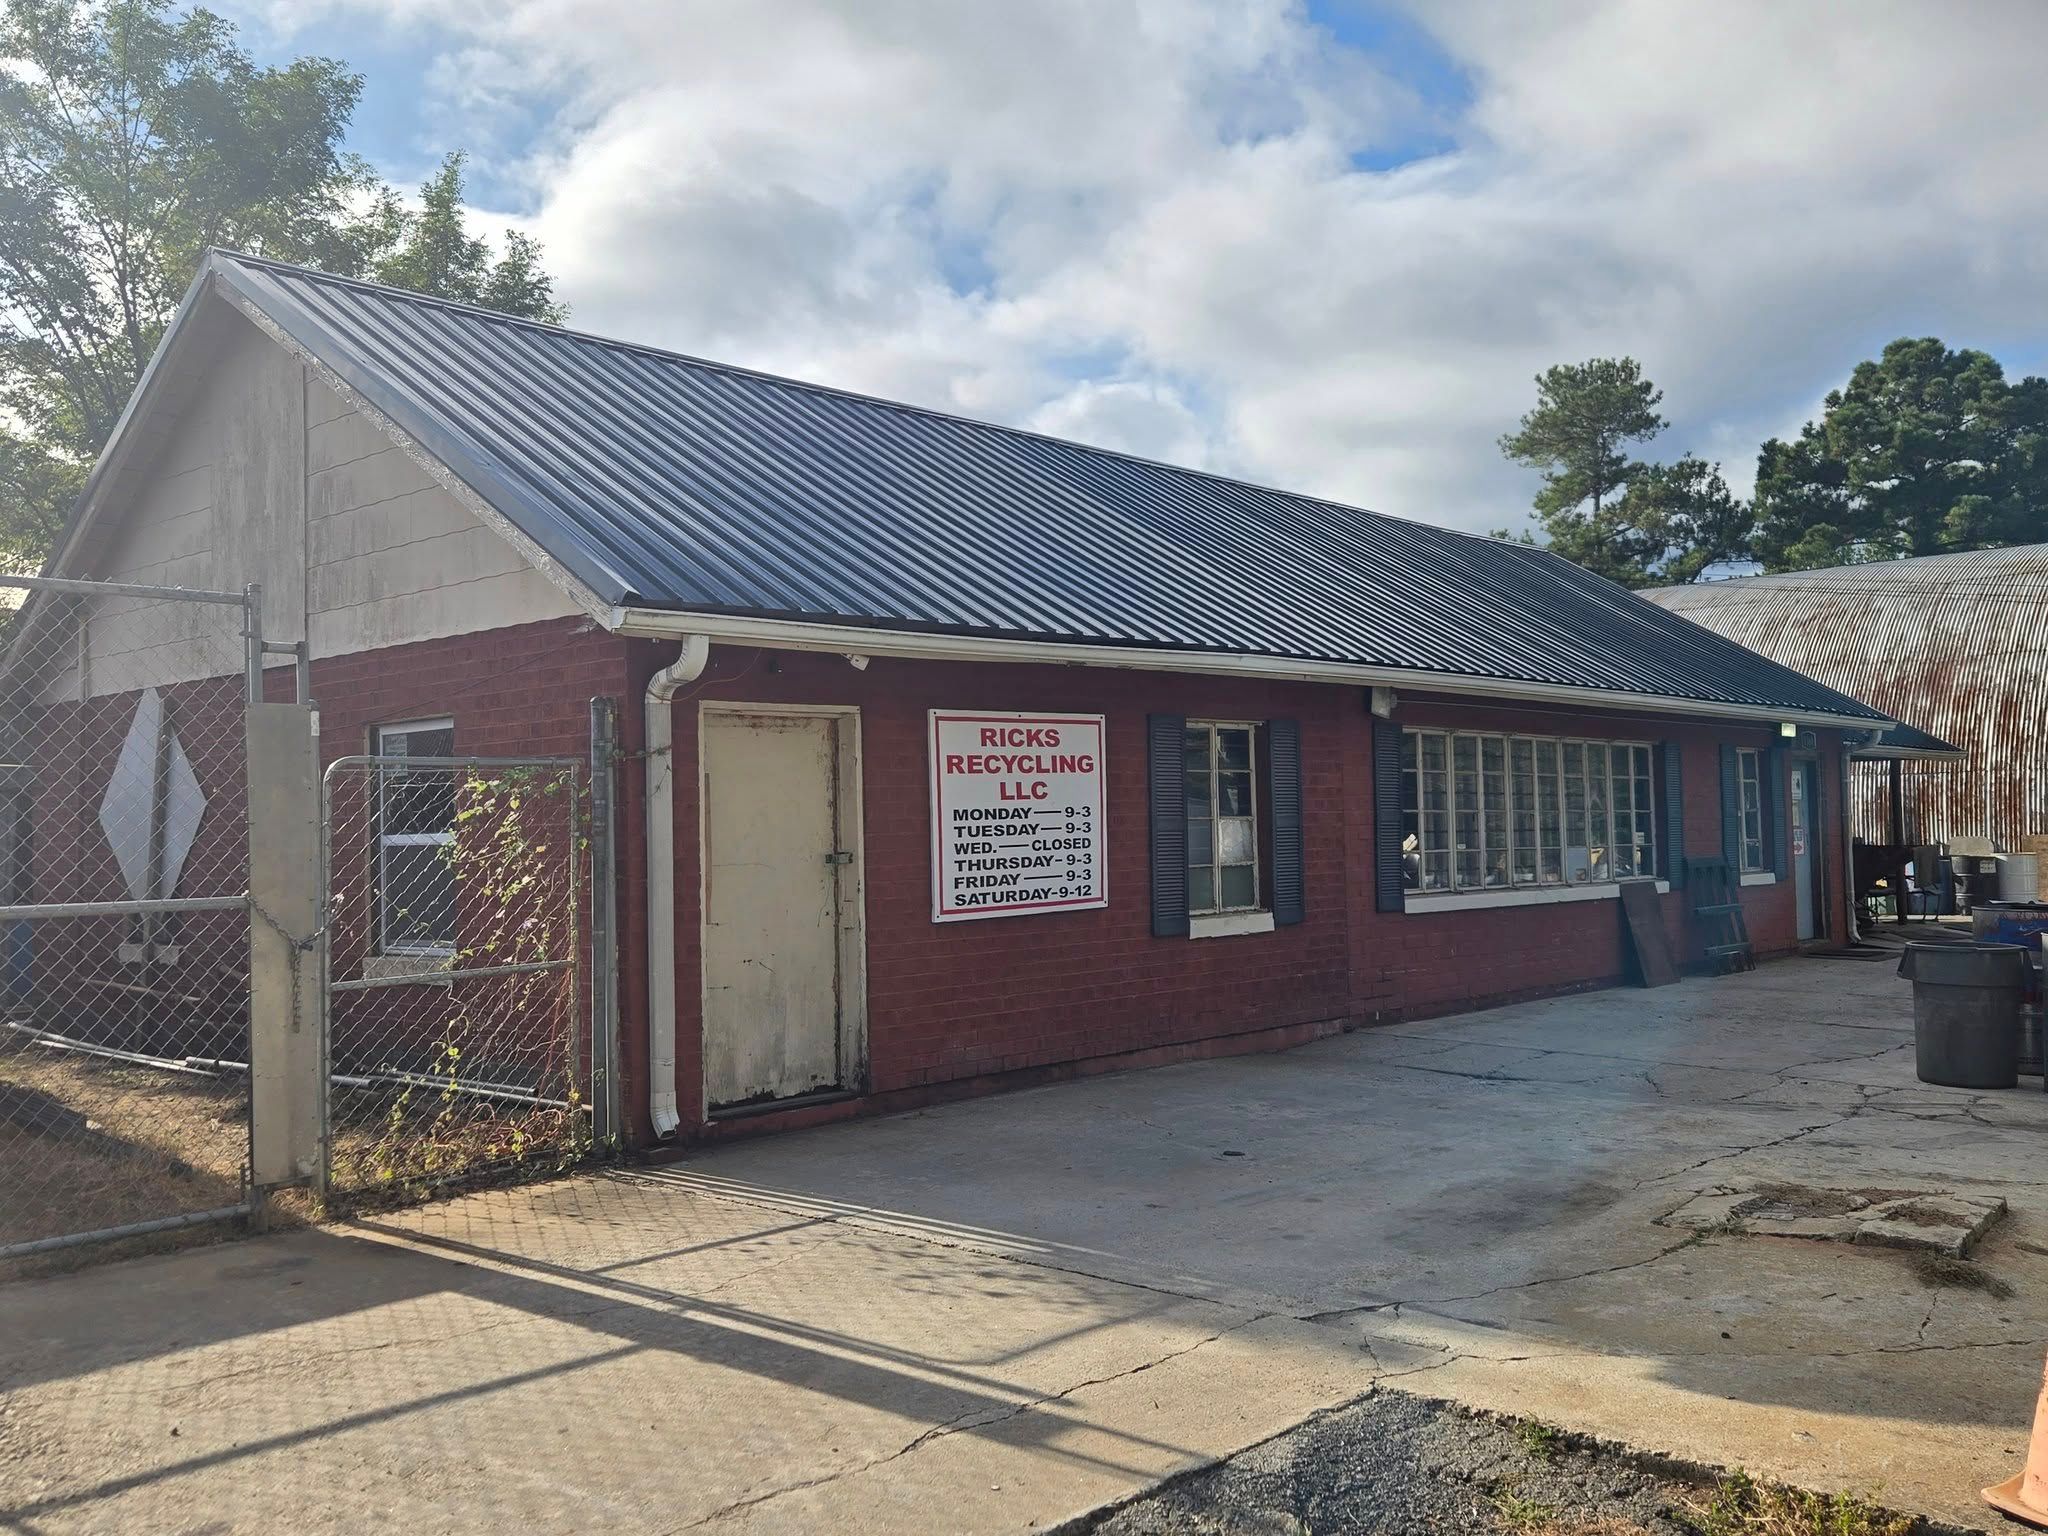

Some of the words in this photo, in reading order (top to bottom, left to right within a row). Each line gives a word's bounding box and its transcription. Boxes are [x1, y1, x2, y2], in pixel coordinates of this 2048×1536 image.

[981, 728, 1060, 747] RICKS
[946, 755, 1094, 774] RECYCLING
[1000, 781, 1048, 800] LLC
[953, 807, 1032, 821] MONDAY
[1065, 806, 1090, 817] 9-3
[954, 824, 1039, 837] TUESDAY
[1065, 822, 1091, 833] 9-3
[955, 842, 996, 855] WED.
[1031, 838, 1091, 851] CLOSED
[1066, 854, 1091, 865] 9-3
[954, 874, 1021, 889] FRIDAY
[1066, 870, 1091, 881] 9-3
